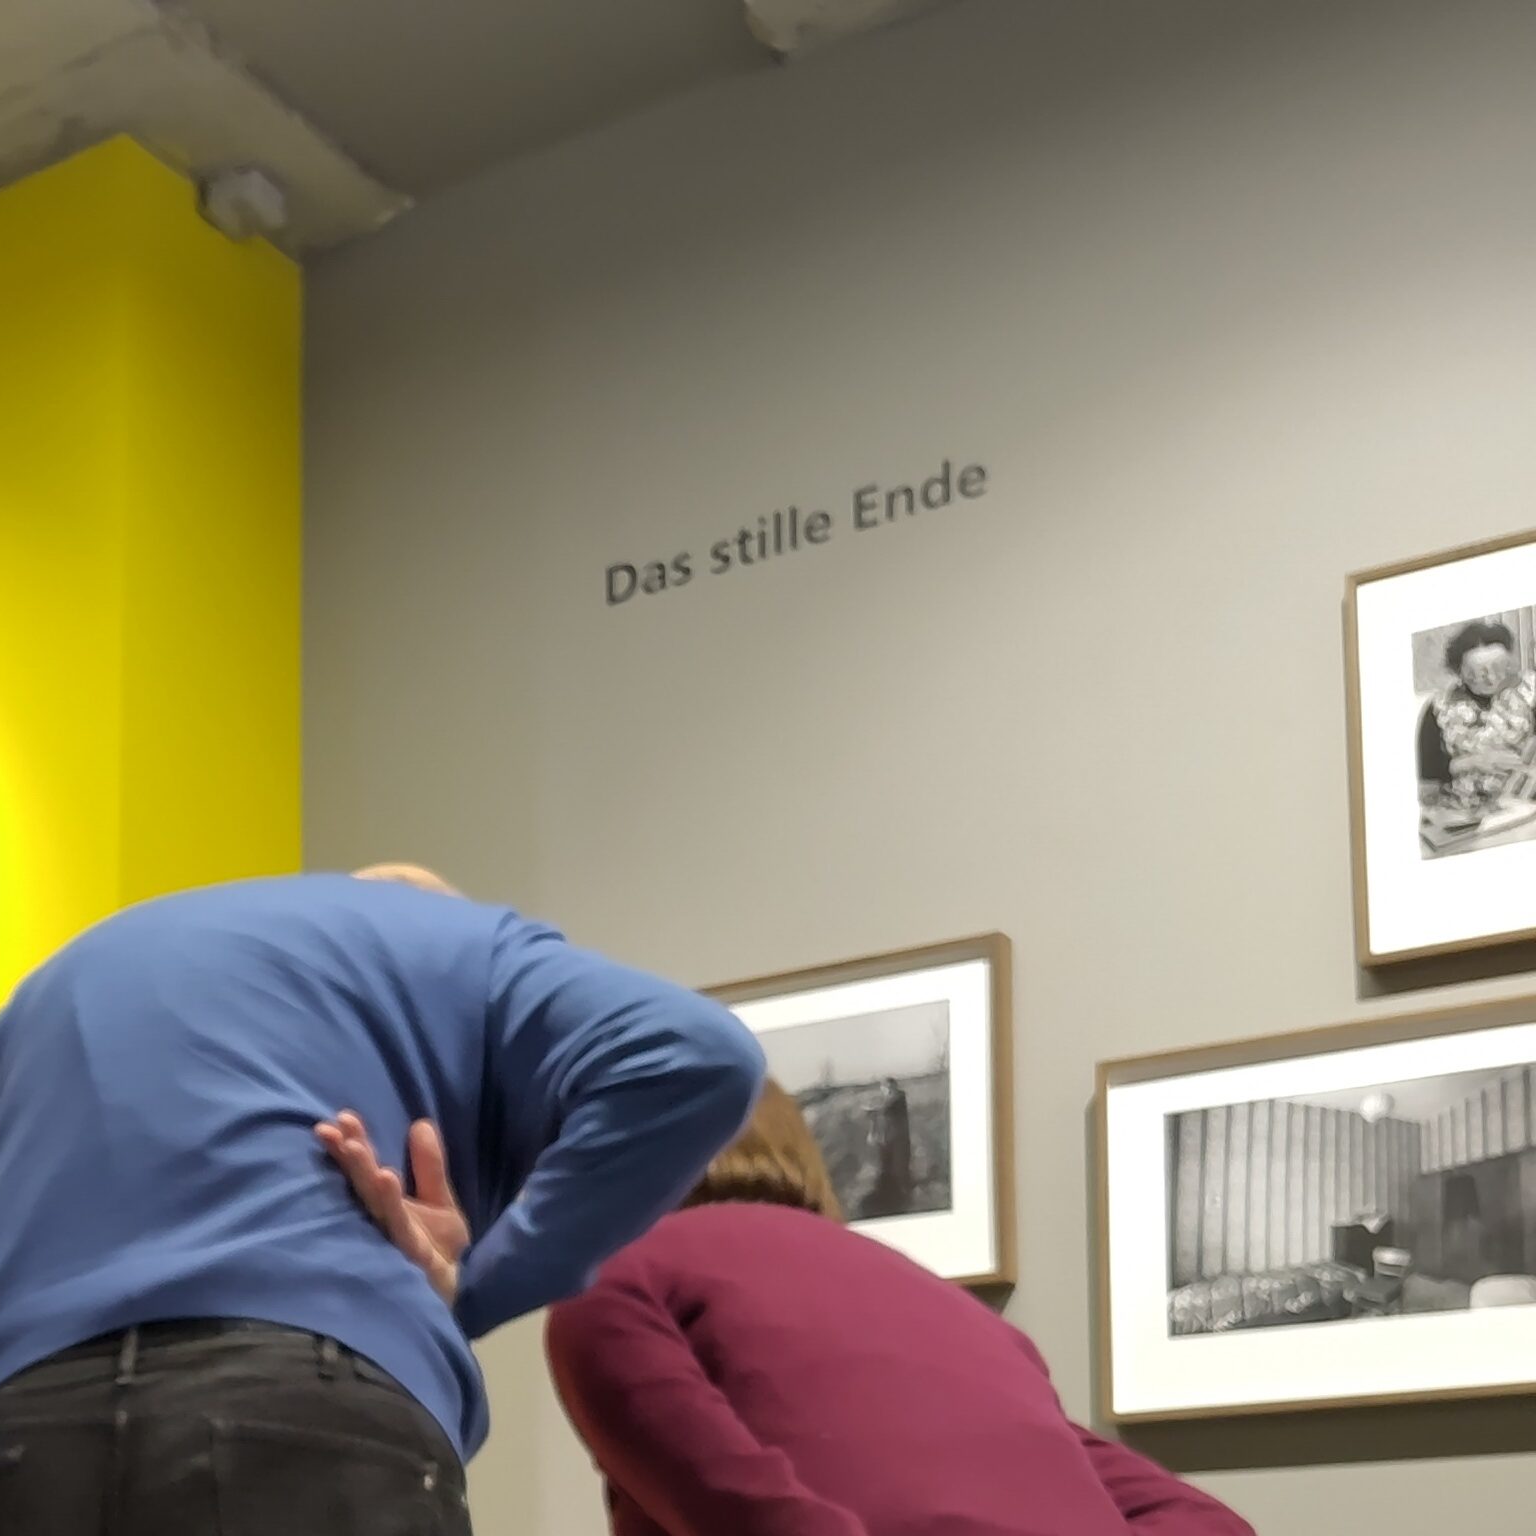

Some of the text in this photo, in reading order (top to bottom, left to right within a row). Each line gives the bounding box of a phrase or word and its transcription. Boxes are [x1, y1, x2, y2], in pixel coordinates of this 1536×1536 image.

[605, 458, 987, 606] Das stille Ende
